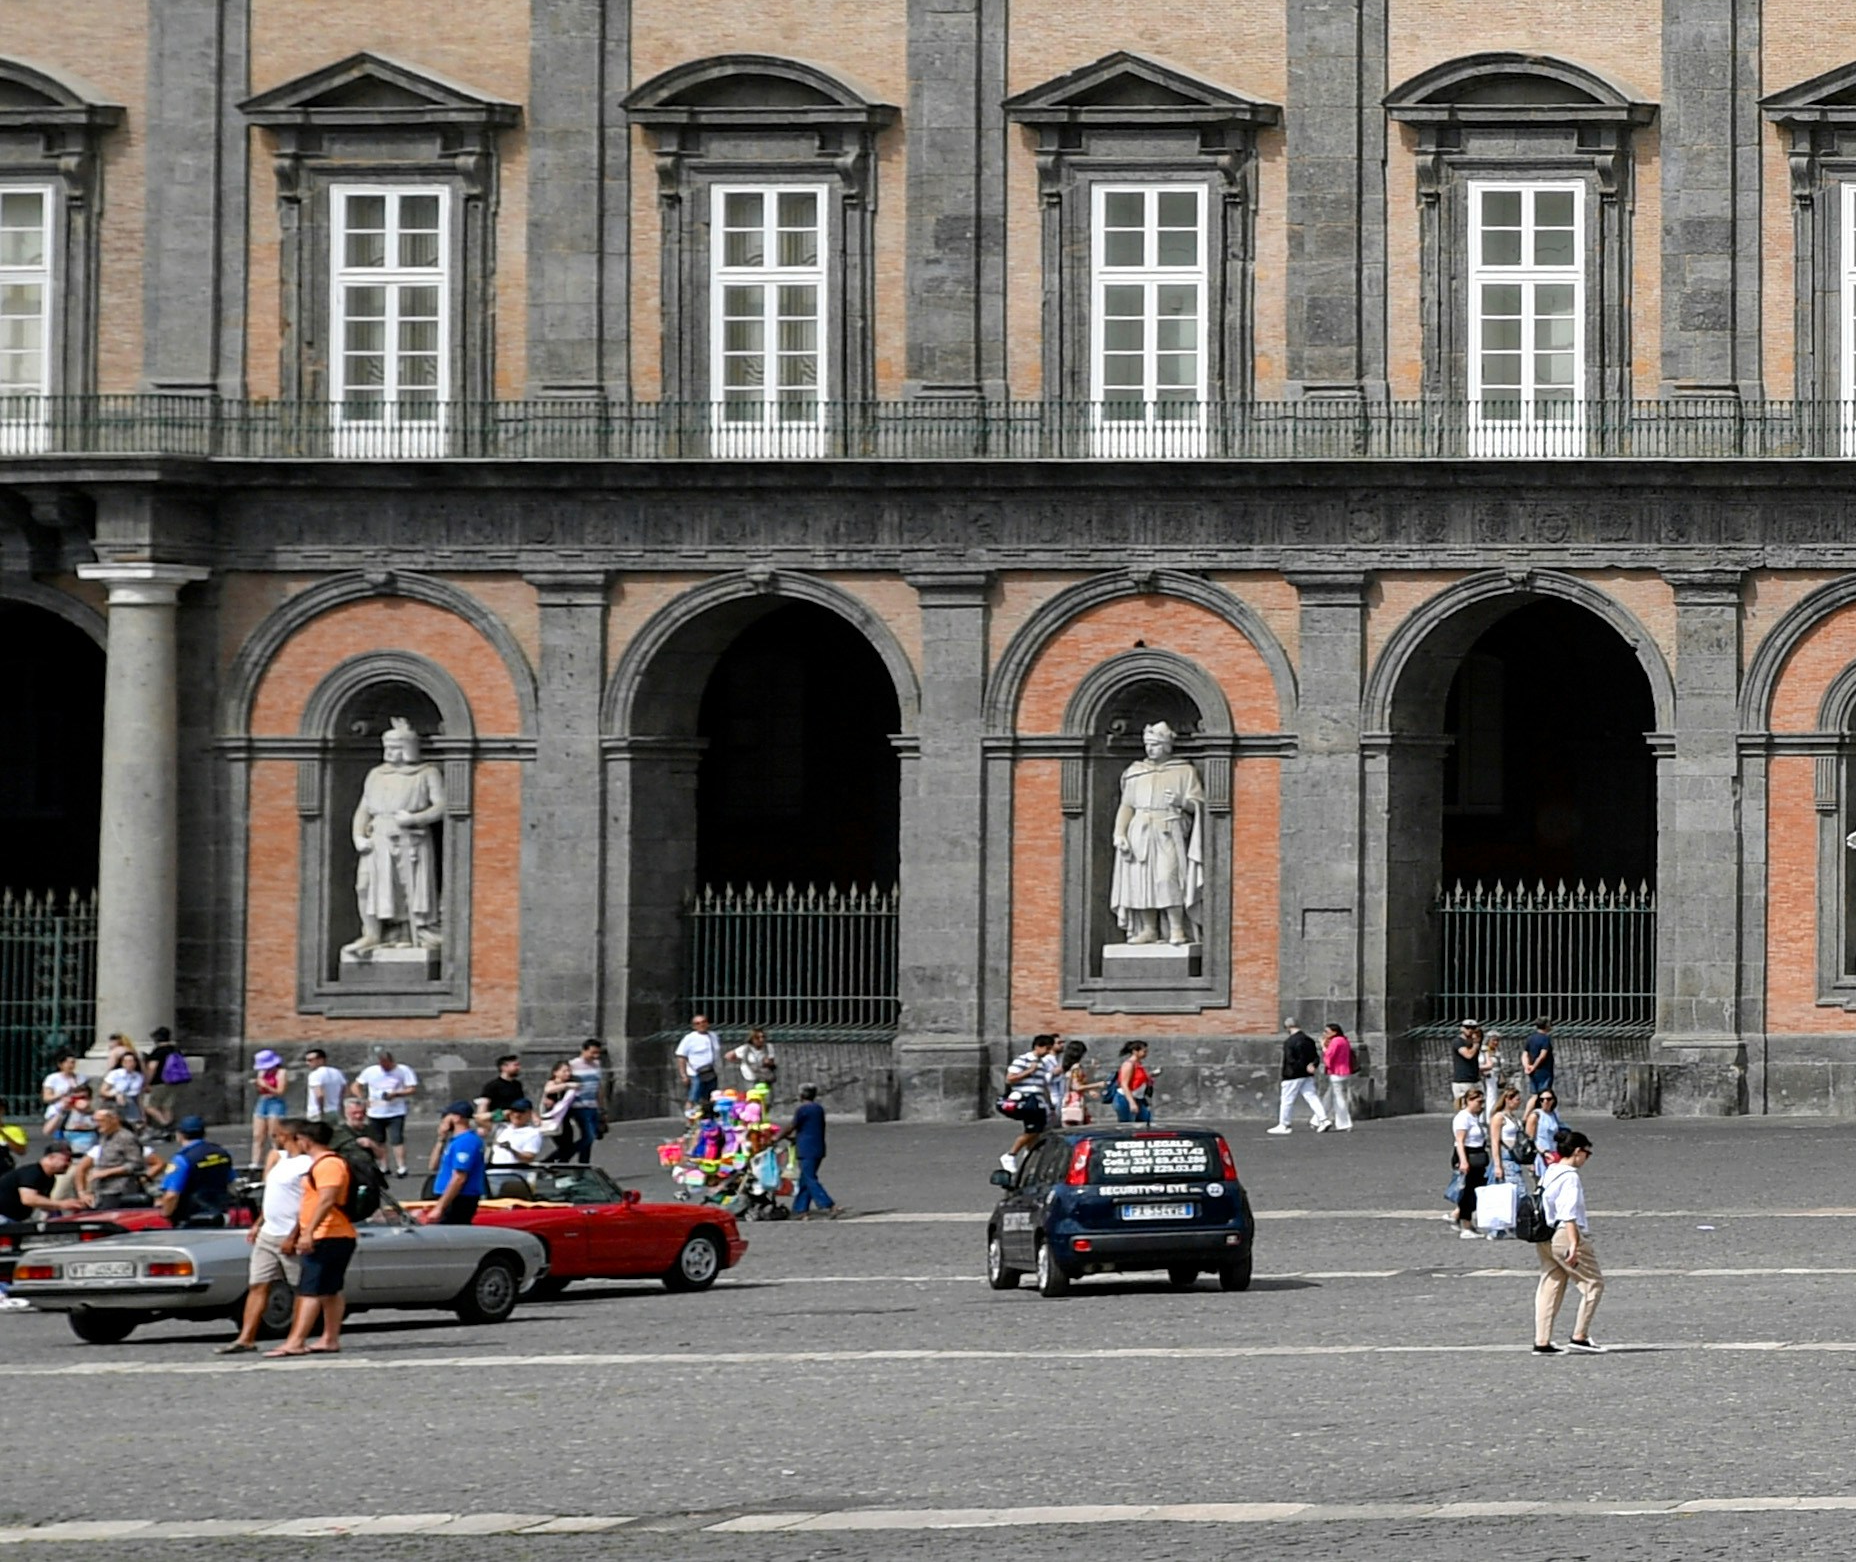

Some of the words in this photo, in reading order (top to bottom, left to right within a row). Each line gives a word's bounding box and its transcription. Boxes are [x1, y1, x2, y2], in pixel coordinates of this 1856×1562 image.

[1114, 1141, 1145, 1149] SEDE
[1099, 1184, 1151, 1196] SECURITY
[1166, 1183, 1188, 1194] EYE
